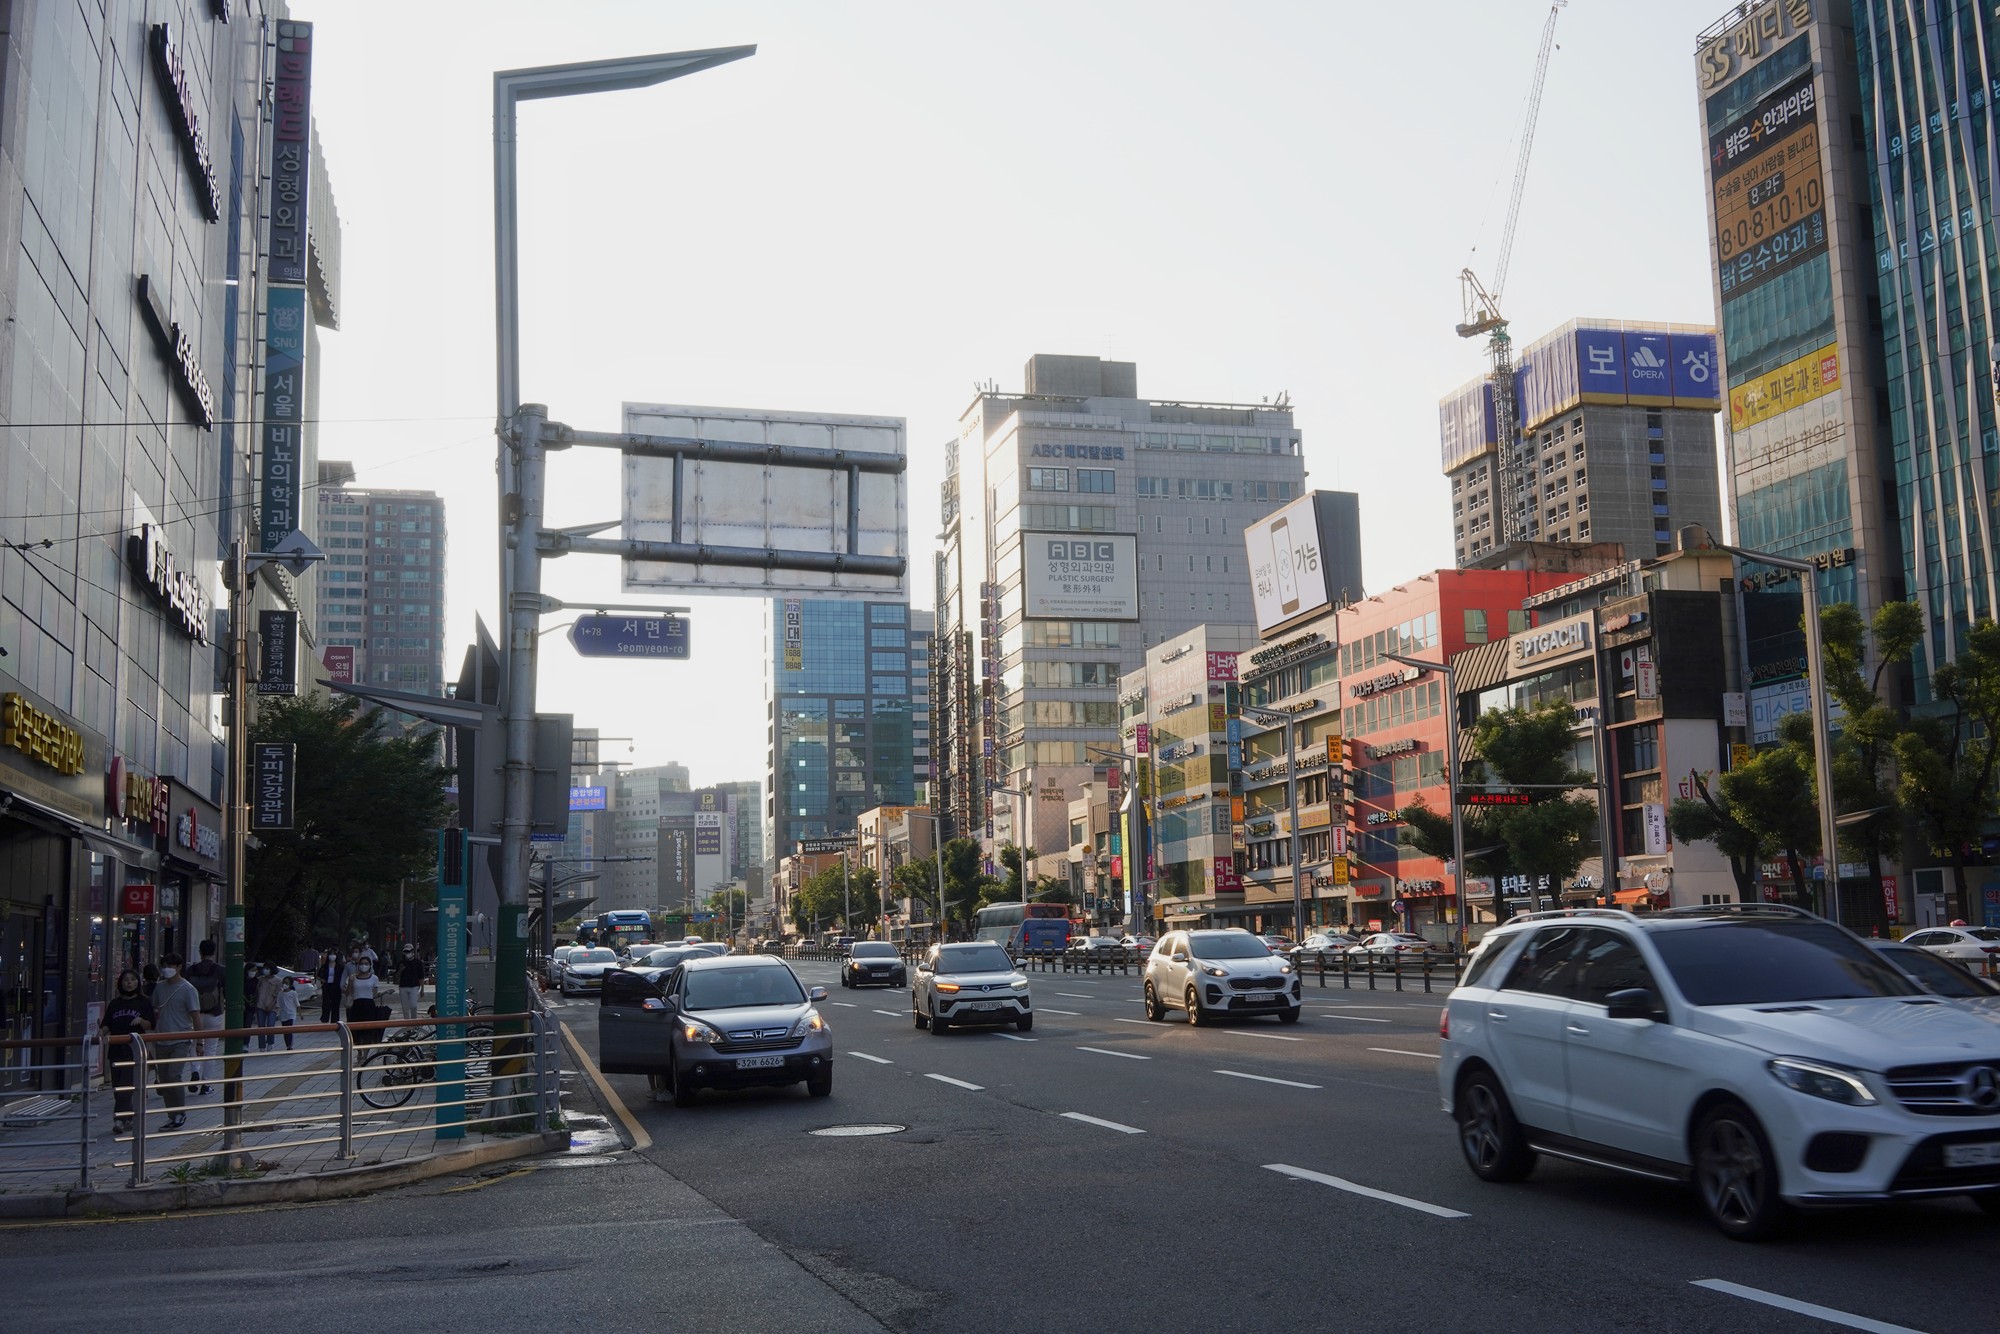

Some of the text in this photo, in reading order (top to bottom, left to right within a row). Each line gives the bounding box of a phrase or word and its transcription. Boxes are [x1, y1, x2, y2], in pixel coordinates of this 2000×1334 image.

[1725, 83, 1815, 159] 밝은수안과의원
[1717, 133, 1814, 200] 수술을 넘어 사람을 봅니다
[1812, 212, 1824, 244] 의원
[1721, 222, 1809, 292] 밝은수안과
[273, 337, 298, 349] SNU
[1588, 345, 1617, 376] 보
[1682, 350, 1710, 383] 성
[1632, 369, 1665, 379] OPERA
[273, 374, 294, 417] 서울
[269, 426, 294, 529] 비뇨의학과
[1050, 542, 1112, 560] ABC
[1295, 542, 1318, 574] 가능
[1048, 561, 1114, 573] 성형외과의원
[1048, 574, 1115, 583] PLASTIC SURGERY
[1062, 584, 1102, 594] 整形外科
[622, 620, 684, 639] 서면로
[787, 612, 800, 640] 임대
[268, 623, 286, 683] 한국표준금거래소
[617, 642, 684, 654] Seomyeon-ro
[258, 682, 294, 692] 932-7377
[12, 692, 86, 776] 한국표준금거래소
[260, 747, 285, 825] 두피건강관리
[569, 788, 602, 797] 종합병원
[1470, 794, 1518, 805] 버스전용차로
[129, 890, 150, 909] 약
[1763, 886, 1774, 898] 약
[446, 921, 460, 1040] Seomyeon Medical Seet
[760, 1056, 781, 1066] 6626
